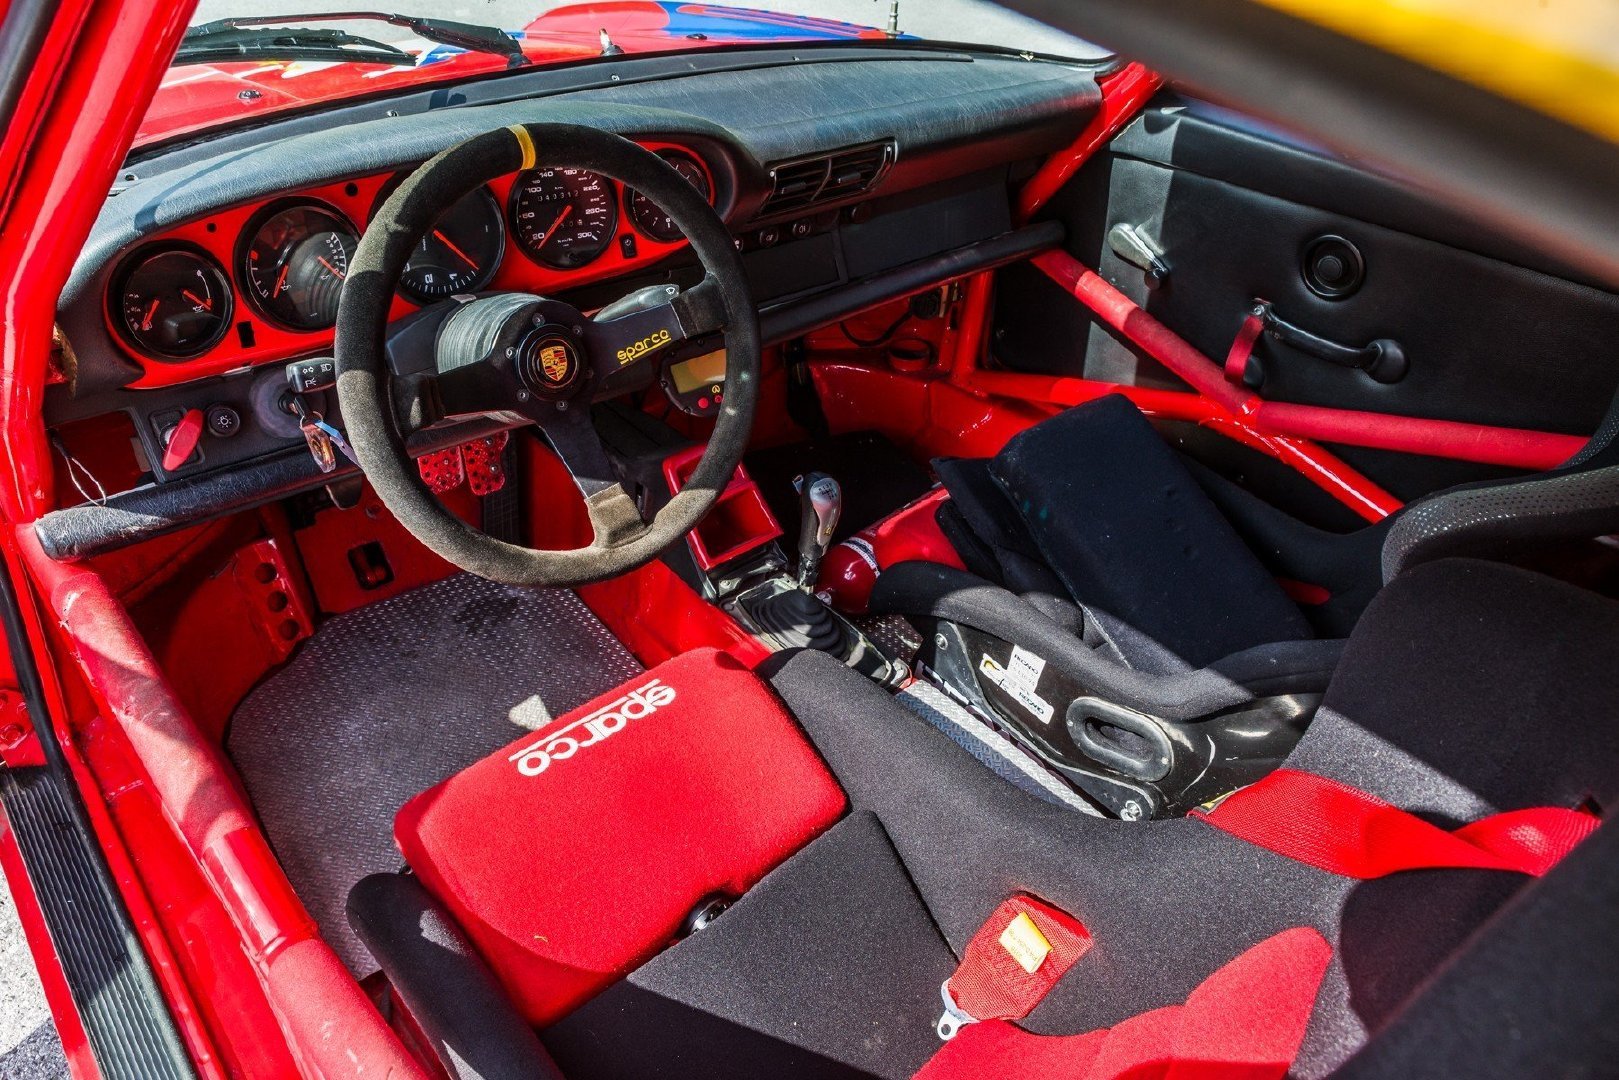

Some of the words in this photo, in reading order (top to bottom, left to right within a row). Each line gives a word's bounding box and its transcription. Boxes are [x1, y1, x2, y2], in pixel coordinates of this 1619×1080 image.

[532, 232, 545, 240] 20
[577, 231, 592, 239] 300
[617, 329, 671, 365] sparco
[515, 684, 677, 777] sparco
